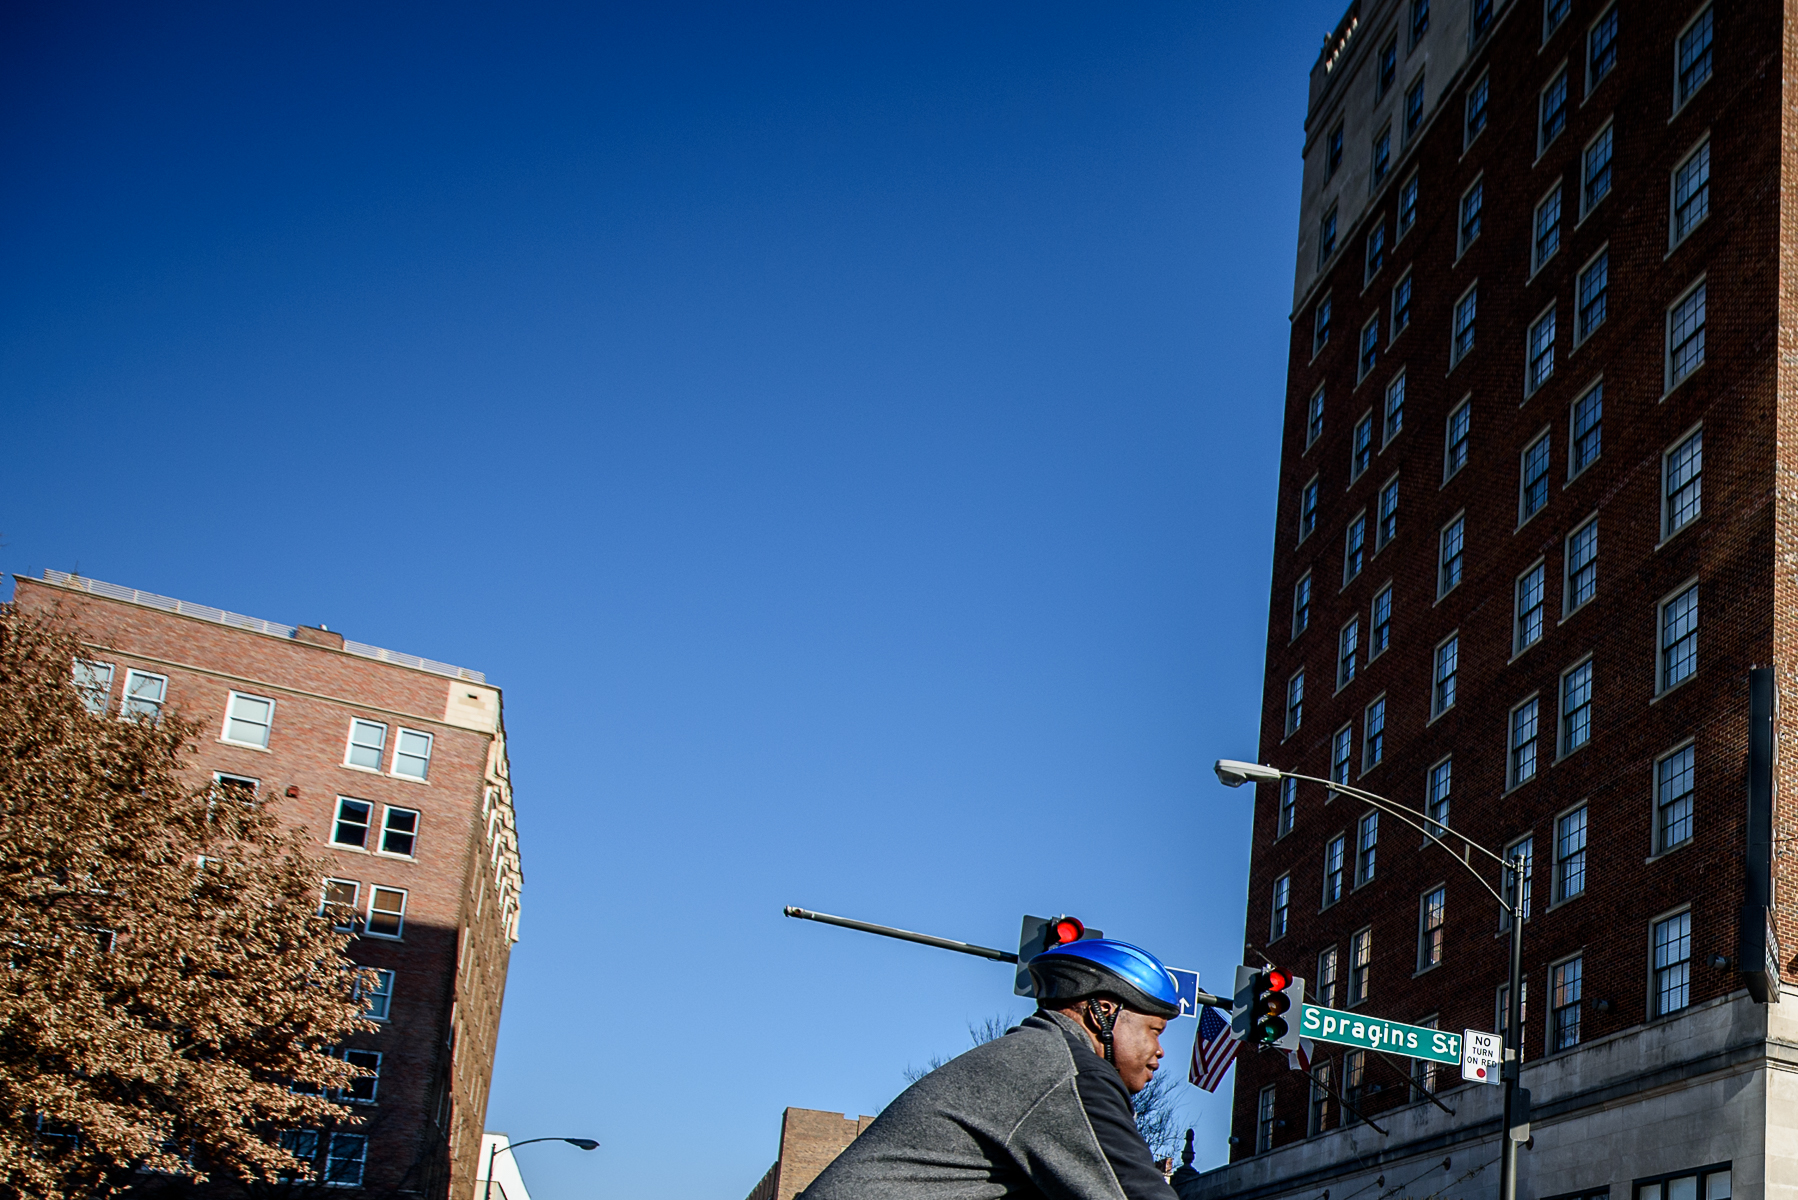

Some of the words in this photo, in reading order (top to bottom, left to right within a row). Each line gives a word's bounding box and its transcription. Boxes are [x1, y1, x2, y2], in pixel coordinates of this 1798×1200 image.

[1303, 1008, 1418, 1048] Spragins
[1432, 1033, 1458, 1057] St
[1475, 1036, 1491, 1047] NO
[1472, 1046, 1494, 1058] TURN
[1467, 1056, 1479, 1065] ON
[1481, 1058, 1498, 1068] RED
